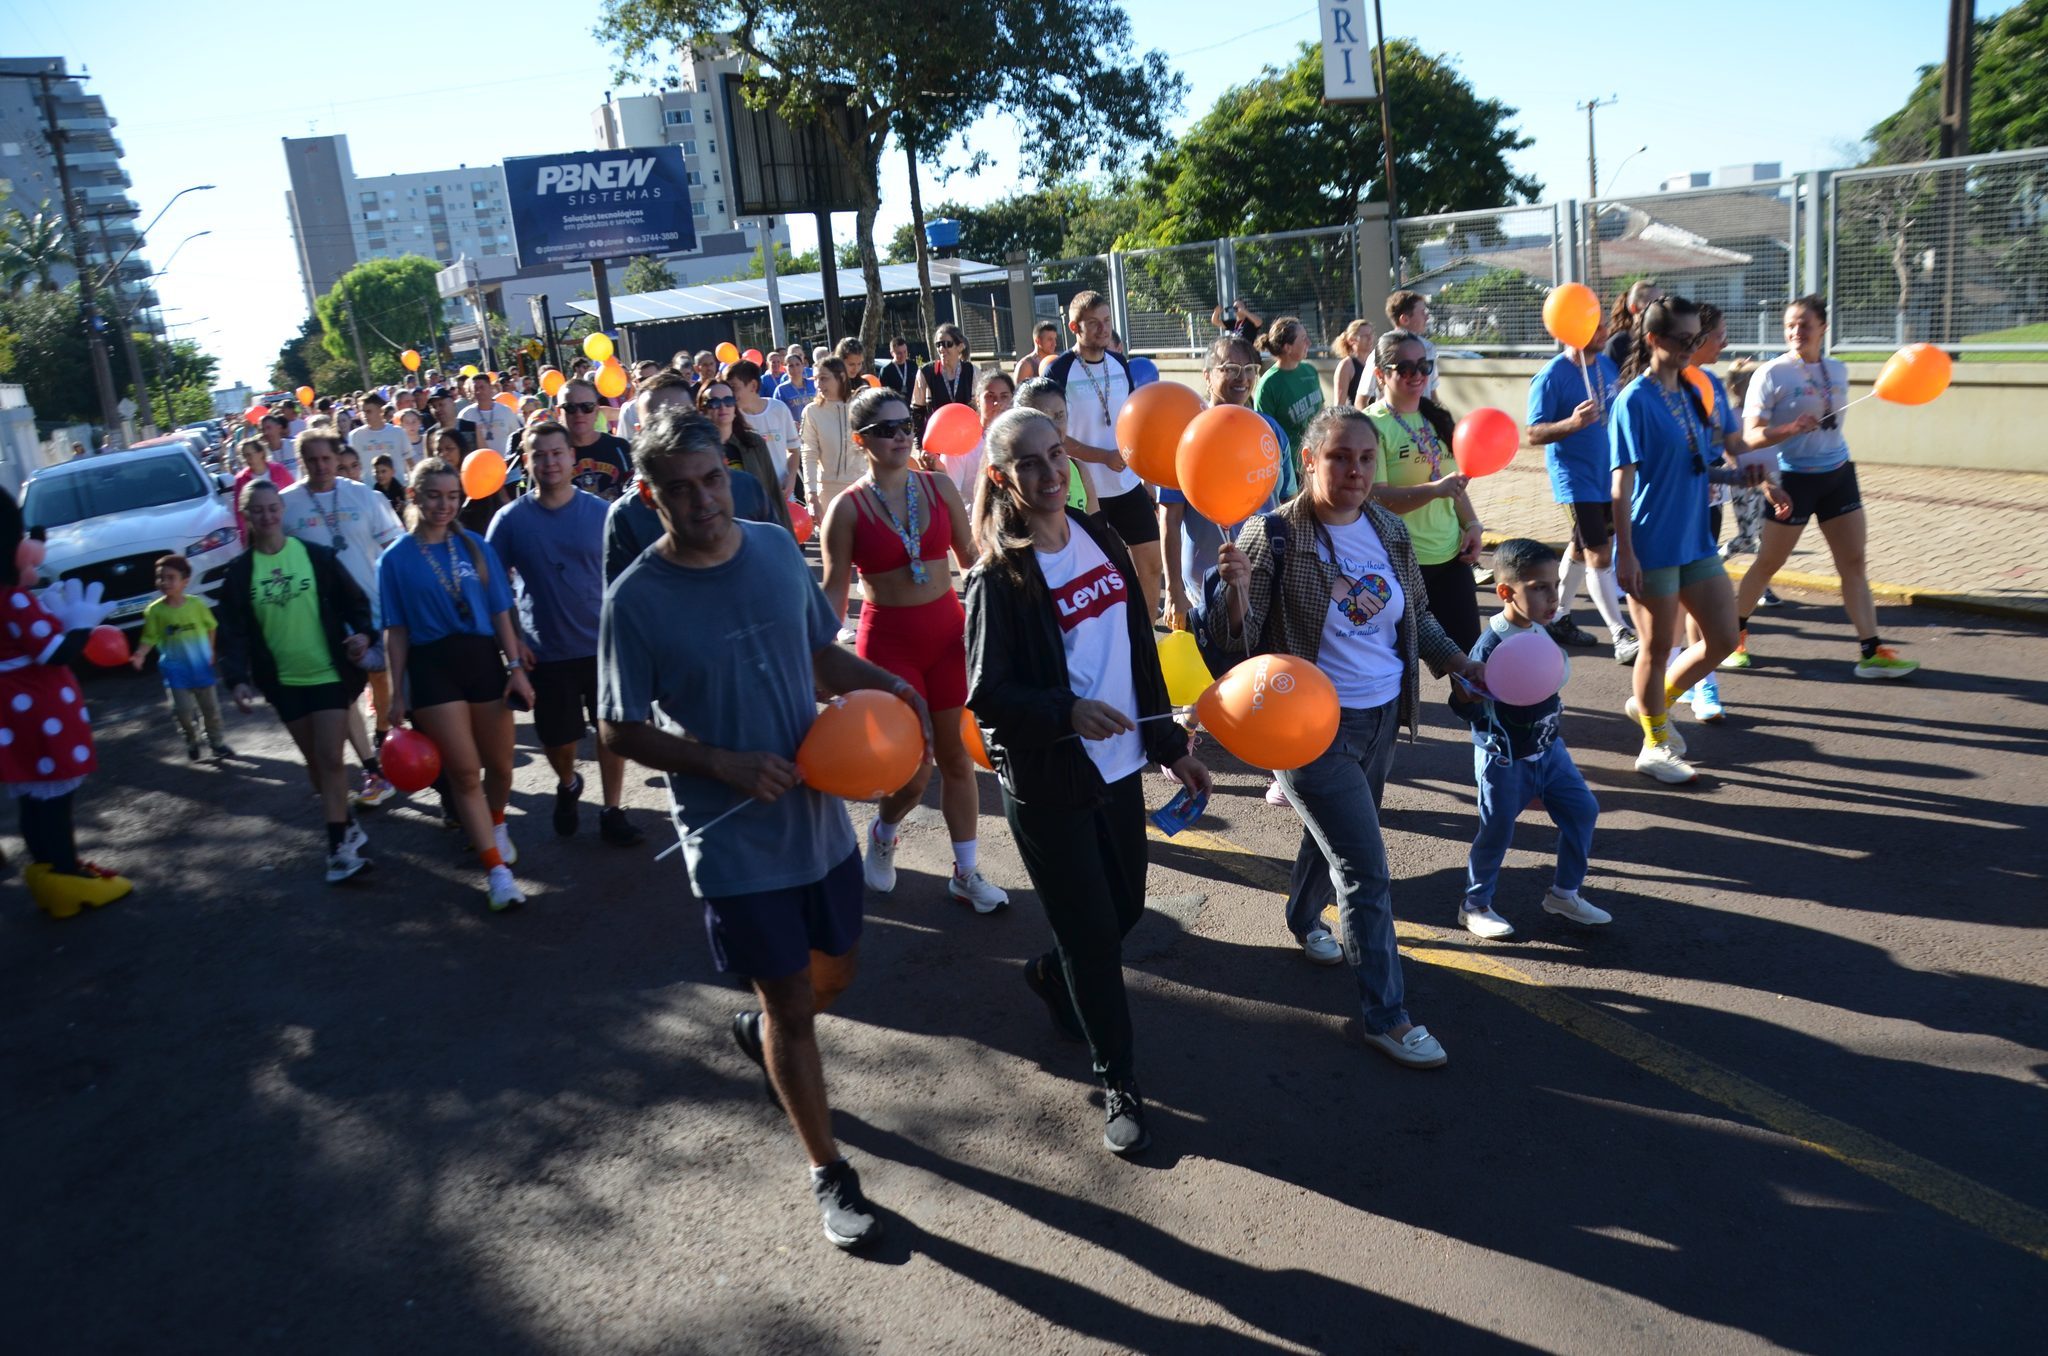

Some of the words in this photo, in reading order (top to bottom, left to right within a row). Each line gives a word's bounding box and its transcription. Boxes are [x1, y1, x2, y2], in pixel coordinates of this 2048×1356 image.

[1331, 0, 1360, 85] RI
[537, 158, 656, 195] PBNEW
[568, 187, 661, 206] SISTEMAS
